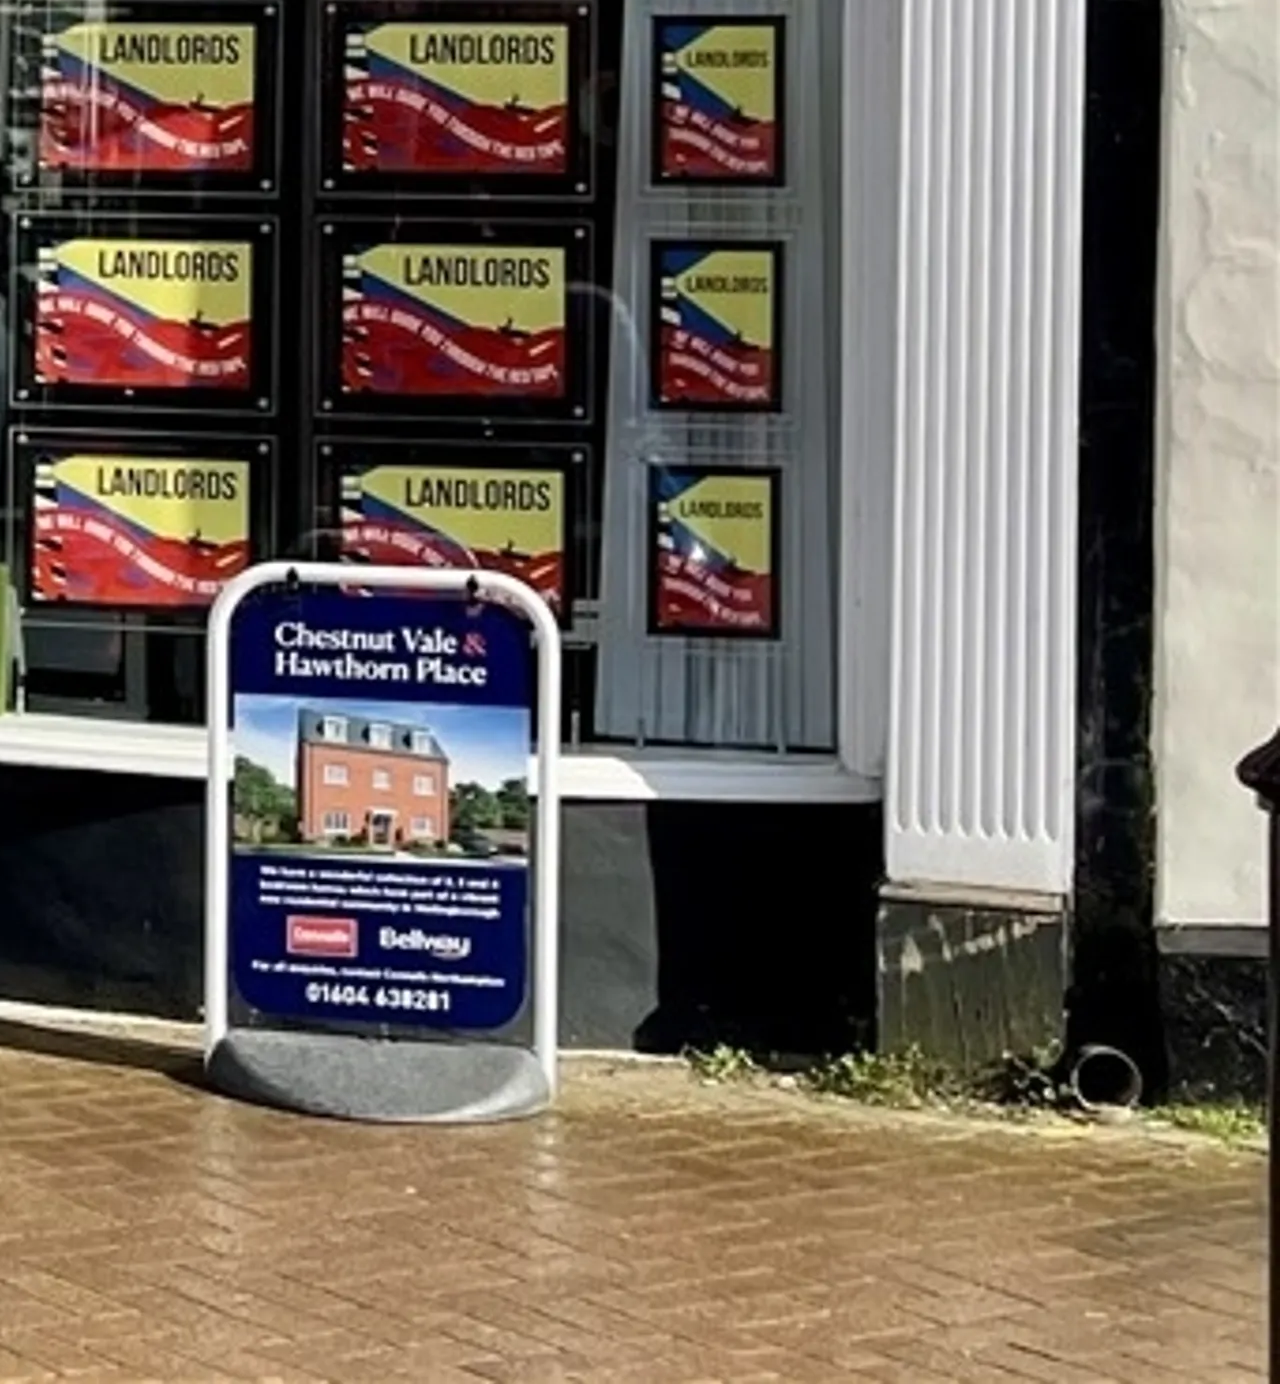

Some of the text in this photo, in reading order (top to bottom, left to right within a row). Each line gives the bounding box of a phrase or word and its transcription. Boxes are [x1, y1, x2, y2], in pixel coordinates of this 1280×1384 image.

[99, 33, 240, 65] LANDLORDS
[409, 33, 555, 65] LANDLORDS
[98, 250, 240, 282] LANDLORDS
[404, 255, 551, 289] LANDLORDS
[97, 466, 239, 500] LANDLORDS
[405, 477, 551, 511] LANDLORDS
[274, 621, 487, 657] Chestnut Vale &
[274, 652, 488, 686] Hawthorn Place
[379, 926, 472, 959] Bellway
[305, 981, 451, 1012] 01604 638281
